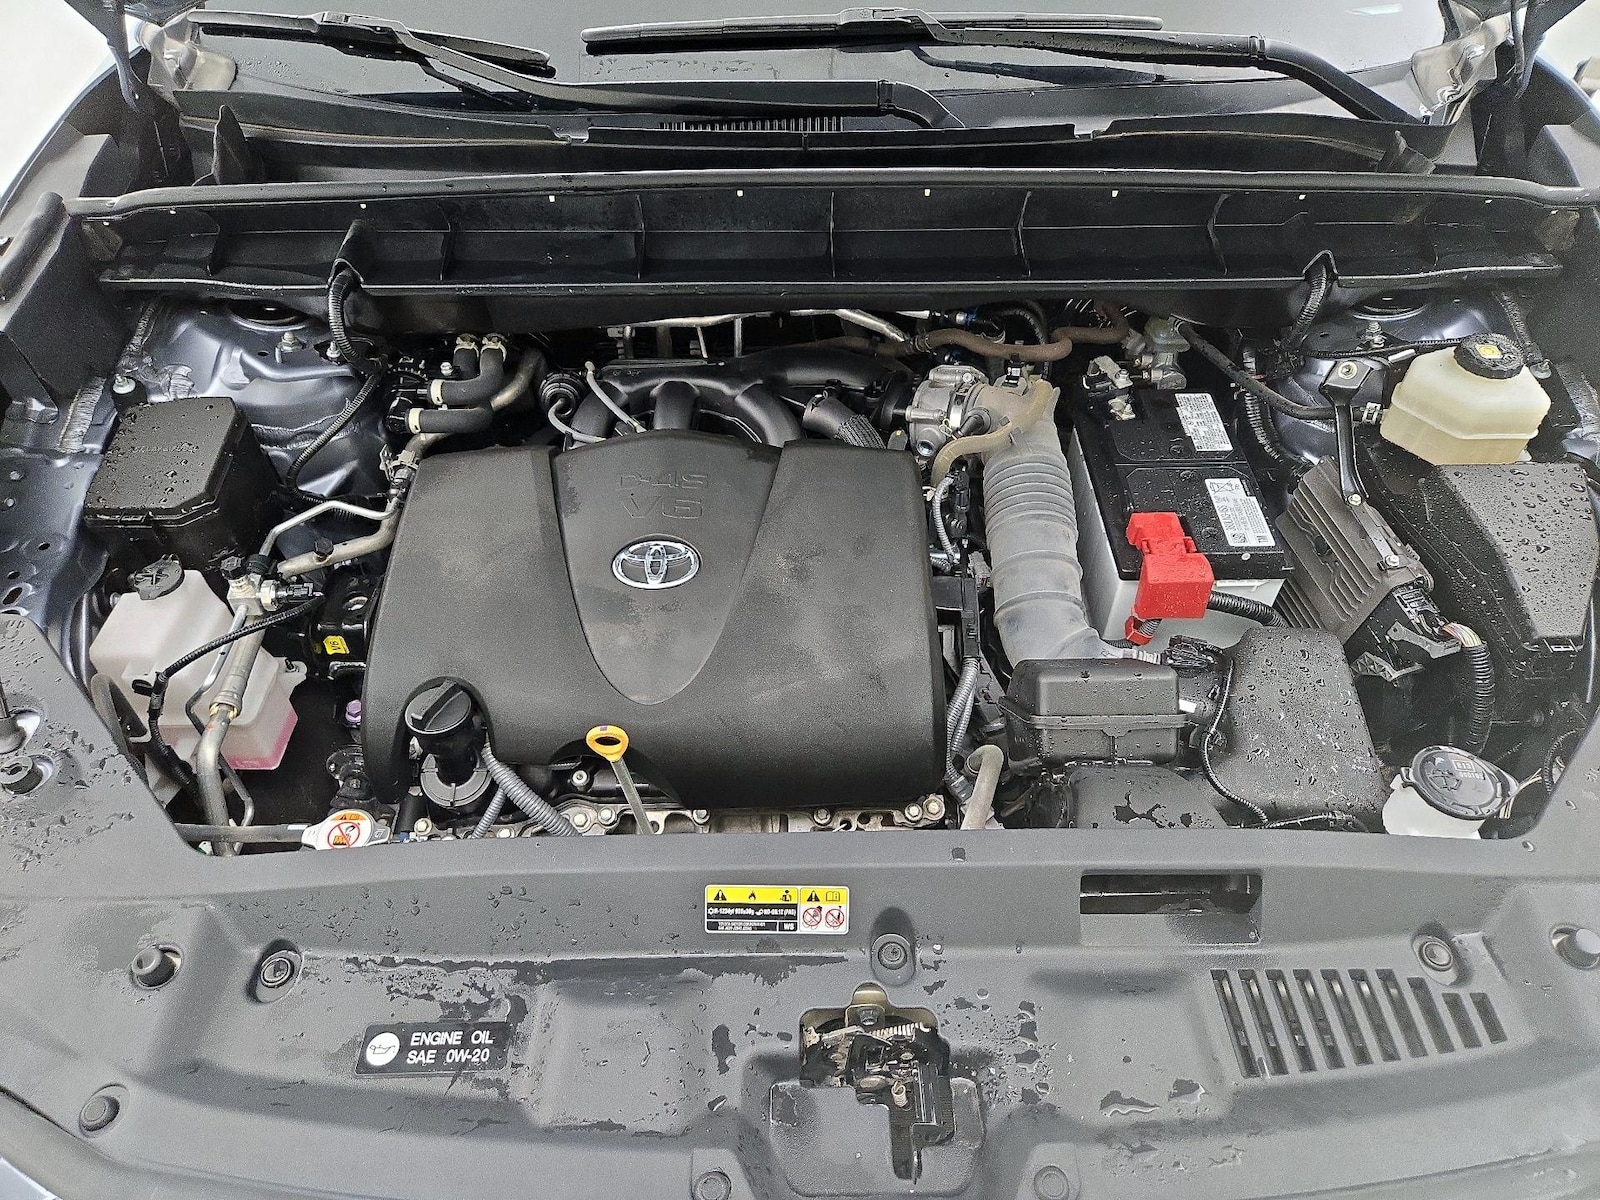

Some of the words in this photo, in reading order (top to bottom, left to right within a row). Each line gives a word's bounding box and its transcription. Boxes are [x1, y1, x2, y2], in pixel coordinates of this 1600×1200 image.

[620, 492, 703, 519] V6
[410, 1030, 463, 1046] ENGINE
[471, 1030, 494, 1045] OIL
[406, 1049, 437, 1064] SAE
[446, 1048, 490, 1063] 0W-20
